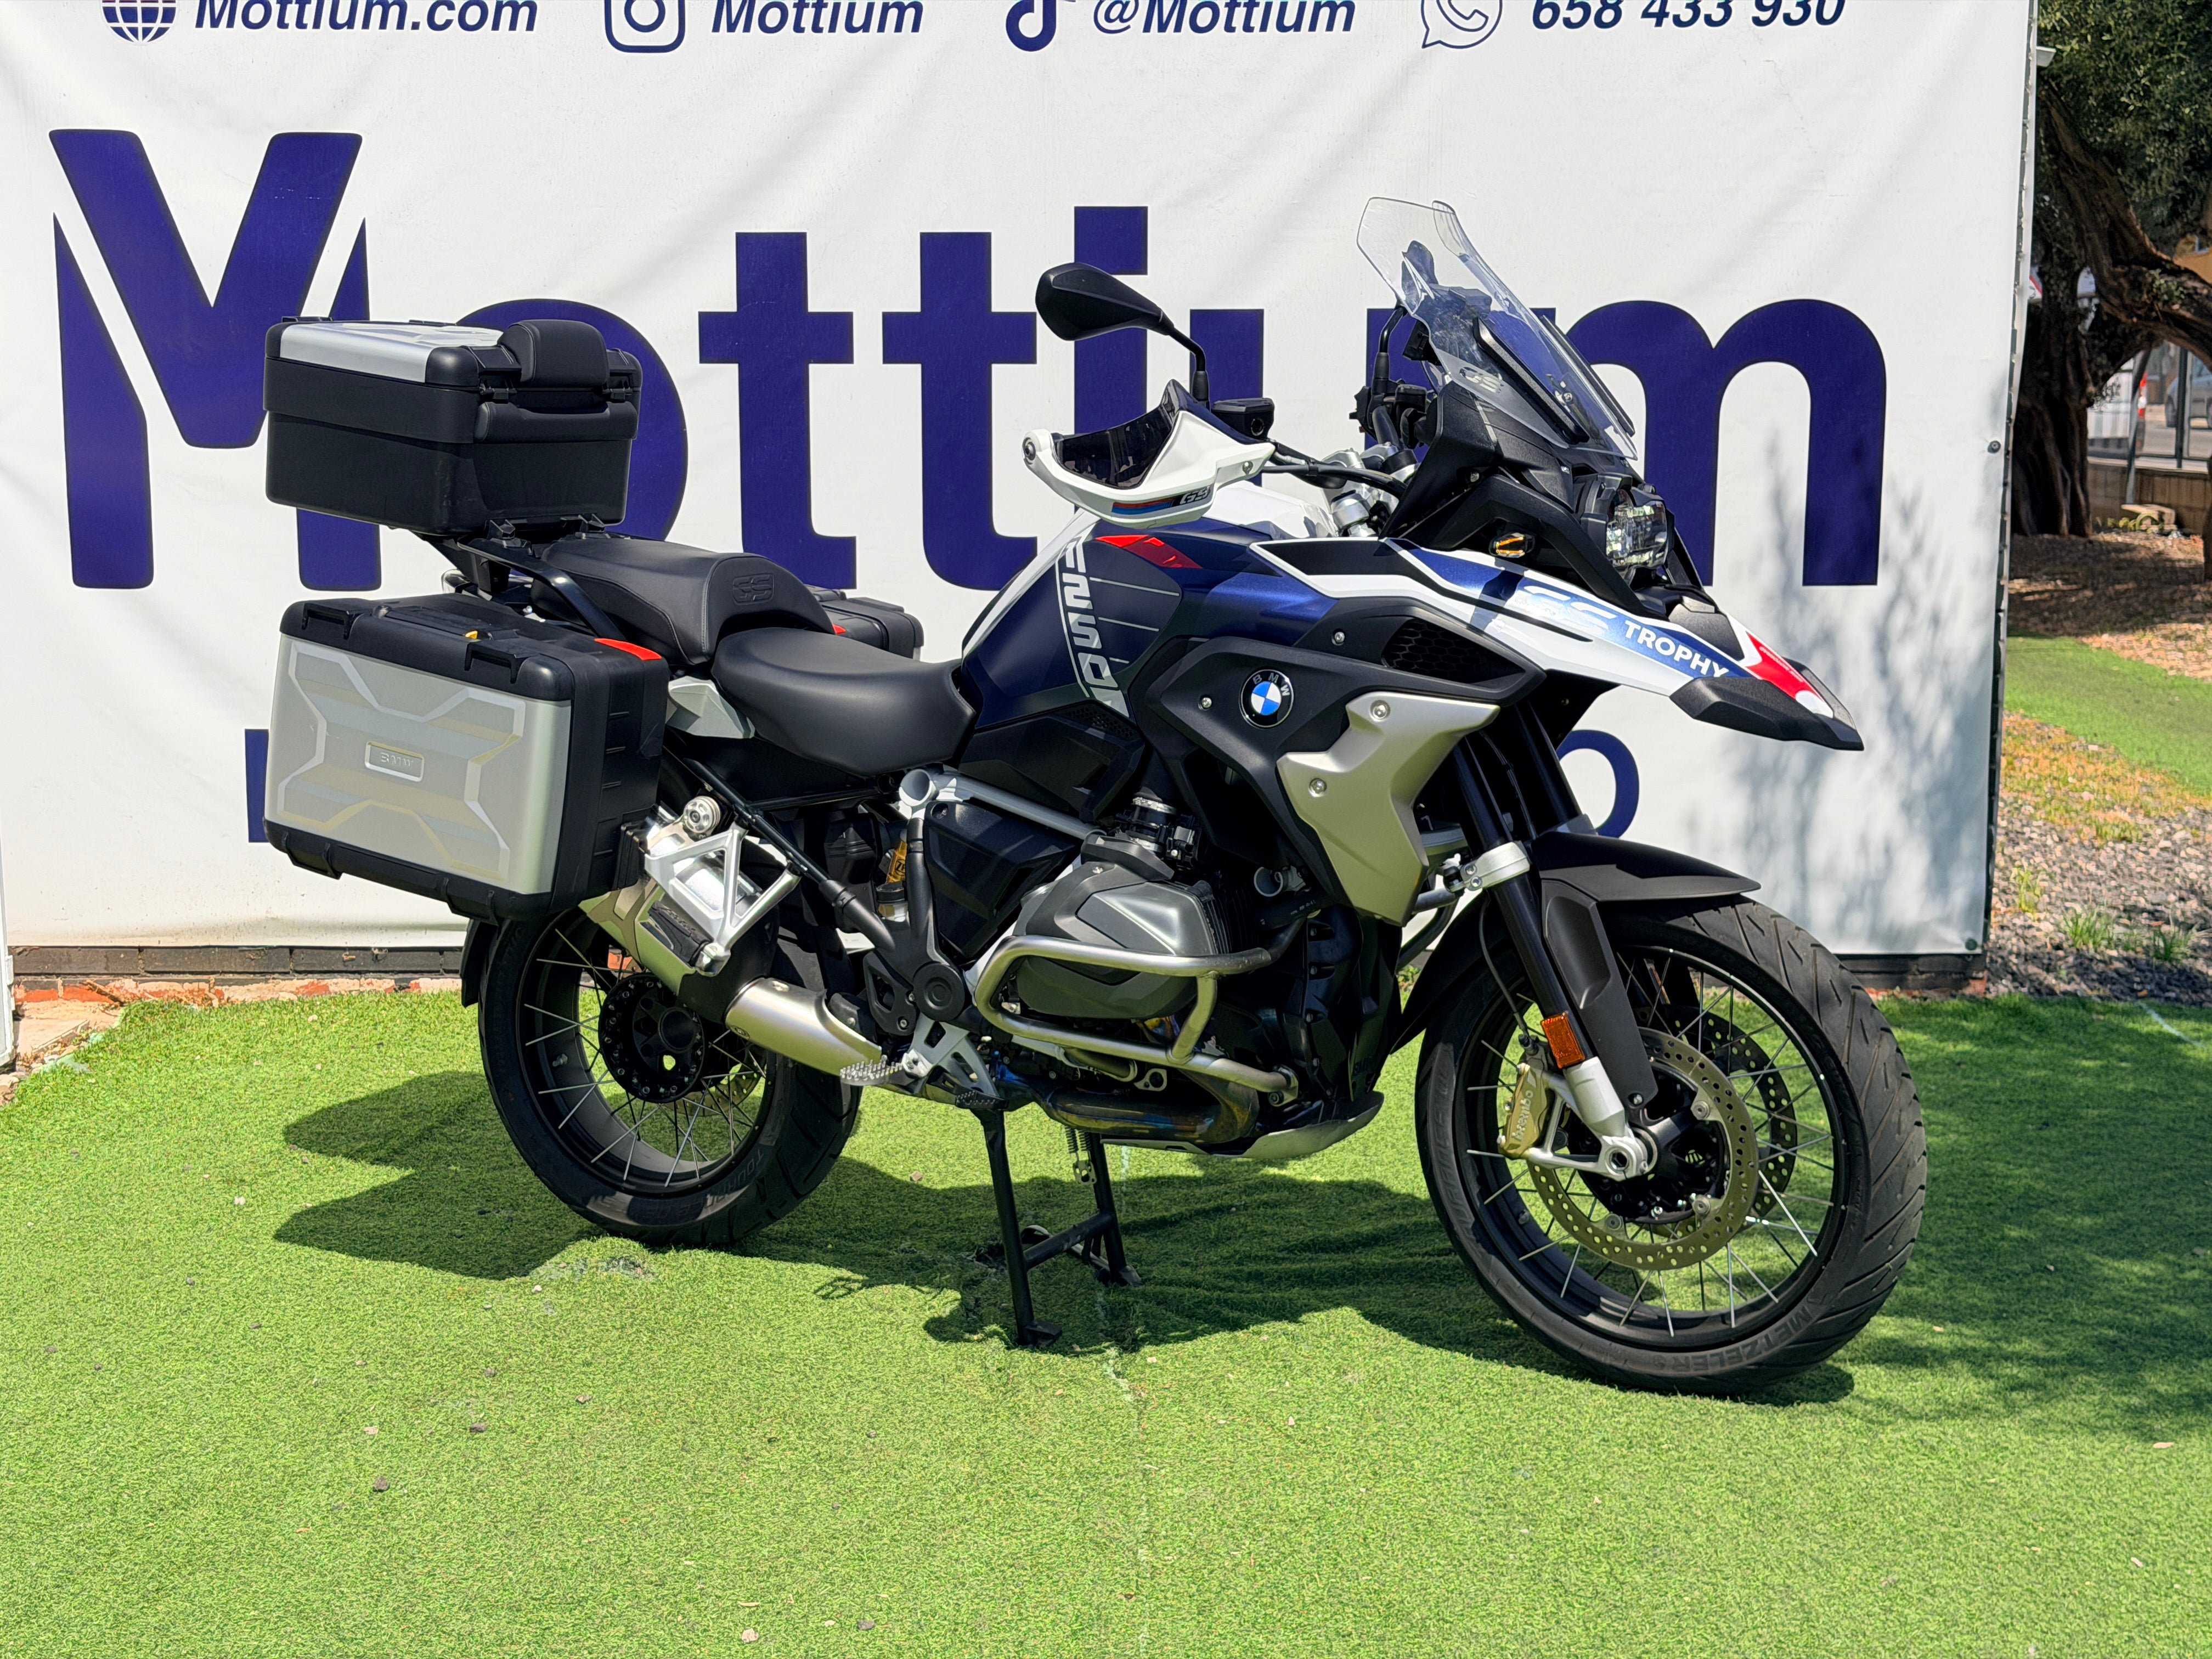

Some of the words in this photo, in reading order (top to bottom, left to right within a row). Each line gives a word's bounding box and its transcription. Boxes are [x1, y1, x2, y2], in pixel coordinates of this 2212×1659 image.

[195, 0, 538, 32] Mottium.com
[712, 0, 924, 34] Mottium
[1093, 0, 1356, 34] @Mottium
[1532, 0, 1623, 30] 658
[1641, 0, 1733, 28] 433
[1751, 0, 1844, 27] 930
[1180, 486, 1210, 505] GS
[1624, 620, 1729, 678] TROPHY
[1252, 672, 1290, 696] BMW
[380, 752, 414, 768] BMW
[1511, 1090, 1534, 1141] brembo
[1672, 1304, 1812, 1372] METZELER
